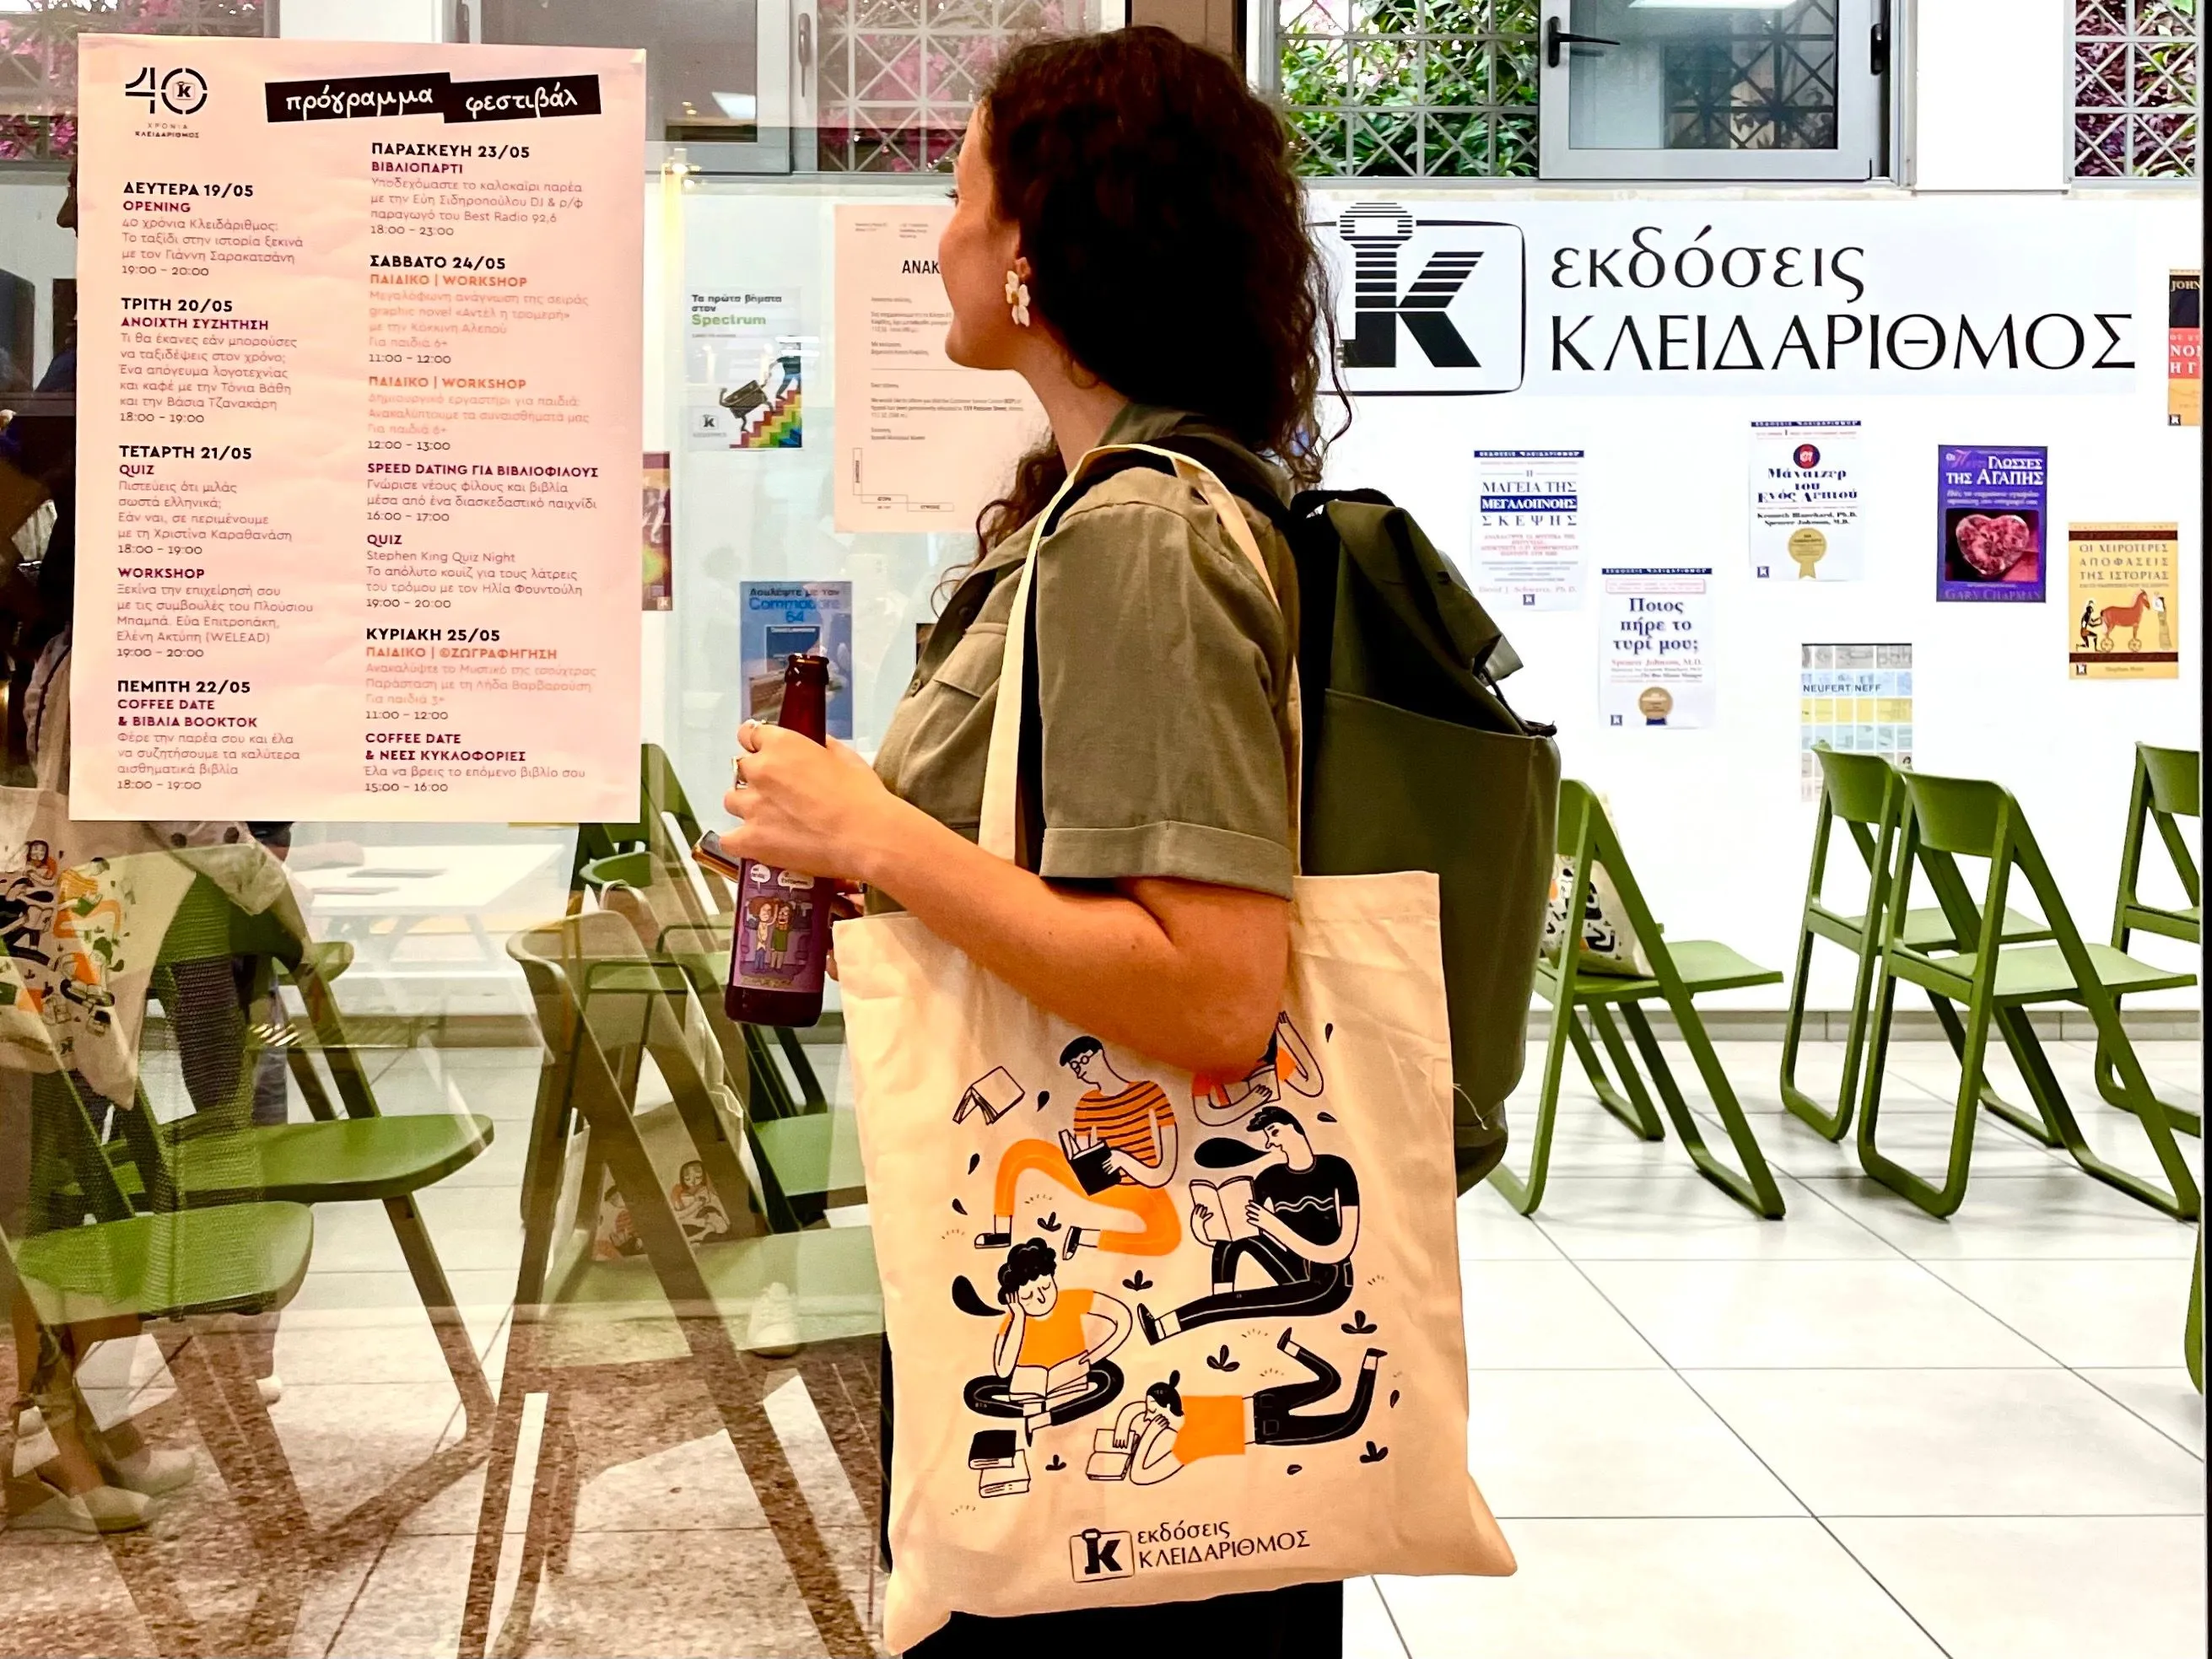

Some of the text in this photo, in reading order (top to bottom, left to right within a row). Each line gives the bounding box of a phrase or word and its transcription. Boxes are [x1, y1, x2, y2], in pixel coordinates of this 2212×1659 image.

[125, 67, 208, 115] 40
[285, 82, 578, 121] πρόγραμμα φεστιβάλ
[372, 143, 529, 159] ΠΑΡΑΣΚΕΥΗ 23/05
[371, 161, 462, 174] ΒΙΒΛΙΟΠΑΡΤΙ
[123, 181, 253, 198] ΔΕΥΤΕΡΑ 19/05
[122, 200, 191, 213] OPENING
[370, 224, 454, 236] 18:00 23:00
[370, 255, 504, 271] ΣΑΒΒΑΤΟ 24/05
[1551, 224, 1864, 304] εκδόσεις
[121, 265, 208, 276] 19:00 20:00
[370, 273, 527, 287] ΠΑΙΔΙΚΟ WORKSHOP
[121, 297, 232, 313] ΤΡΙΤΗ 20/05
[692, 294, 782, 304] Τα πρώτα βήματα
[121, 317, 268, 330] ΑΝΟΙΧΤΗ ΣΥΖΗΤΗΣΗ
[691, 314, 766, 326] Spectrum
[1551, 313, 2135, 371] ΚΛΕΙΔΑΡΙΘΜΟΣ
[369, 353, 451, 364] 11:00 12:00
[368, 375, 526, 390] ΠΑΙΔΙΚΟ WORKSHOP
[120, 412, 204, 423] 18:00 19:00
[368, 440, 450, 451] 12:00 13:00
[118, 445, 251, 461] ΤΕΤΑΡΤΗ 21/05
[119, 464, 154, 477] QUIZ
[367, 463, 598, 477] SPEED DATING ΓΙΑ ΒΙΒΛΙΟΦΙΛΟΥΣ
[1946, 469, 2044, 485] ΤΗΣ ΑΓΑΠΗΣ
[1482, 482, 1577, 493] ΜΑΓΕΙΑ ΤΗΣ
[367, 510, 449, 522] 16:00 17:00
[367, 534, 402, 547] QUIZ
[117, 543, 202, 555] 18:00 19:00
[2100, 544, 2168, 552] ΧΕΙΡΟΤΕΡΕΣ
[365, 550, 515, 564] Stephen King Quiz Night
[2080, 557, 2168, 567] ΑΠΟΦΑΣΕΙΣ
[117, 568, 204, 579] WORKSHOP
[2080, 571, 2168, 580] ΤΗΣ ΙΣΤΟΡΙΑΣ
[366, 599, 450, 608] 19:00 20:00
[1629, 597, 1684, 613] Ποιος
[785, 611, 804, 622] 64
[1621, 617, 1691, 638] πήρε το
[366, 628, 499, 643] ΚΥΡΙΑΚΗ 25/05
[366, 646, 426, 657] ΠΑΙΔΙΚΟ
[1613, 637, 1698, 655] τυρί μου;
[116, 648, 203, 658] 19:00 20:00
[117, 679, 250, 694] ΠΕΜΠΤΗ 22/05
[1803, 684, 1882, 692] NEUFERT NEFF
[117, 699, 214, 709] COFFEE DATE
[365, 710, 448, 719] 11:00 12:00
[132, 716, 180, 726] ΒΙΒΛΙΑ
[184, 717, 256, 727] BOOKTOK
[365, 733, 461, 744] COFFEE DATE
[380, 750, 415, 760] ΝΕΕΣ
[420, 750, 526, 761] ΚΥΚΛΟΦΟΡΙΕΣ
[117, 779, 201, 790] 18:00 19:00
[364, 782, 448, 793] 15:00 16:00
[1137, 1520, 1230, 1544] εκδόσεις
[1140, 1530, 1310, 1569] ΚΛΕΙΔΑΡΙΘΜΟΣ
